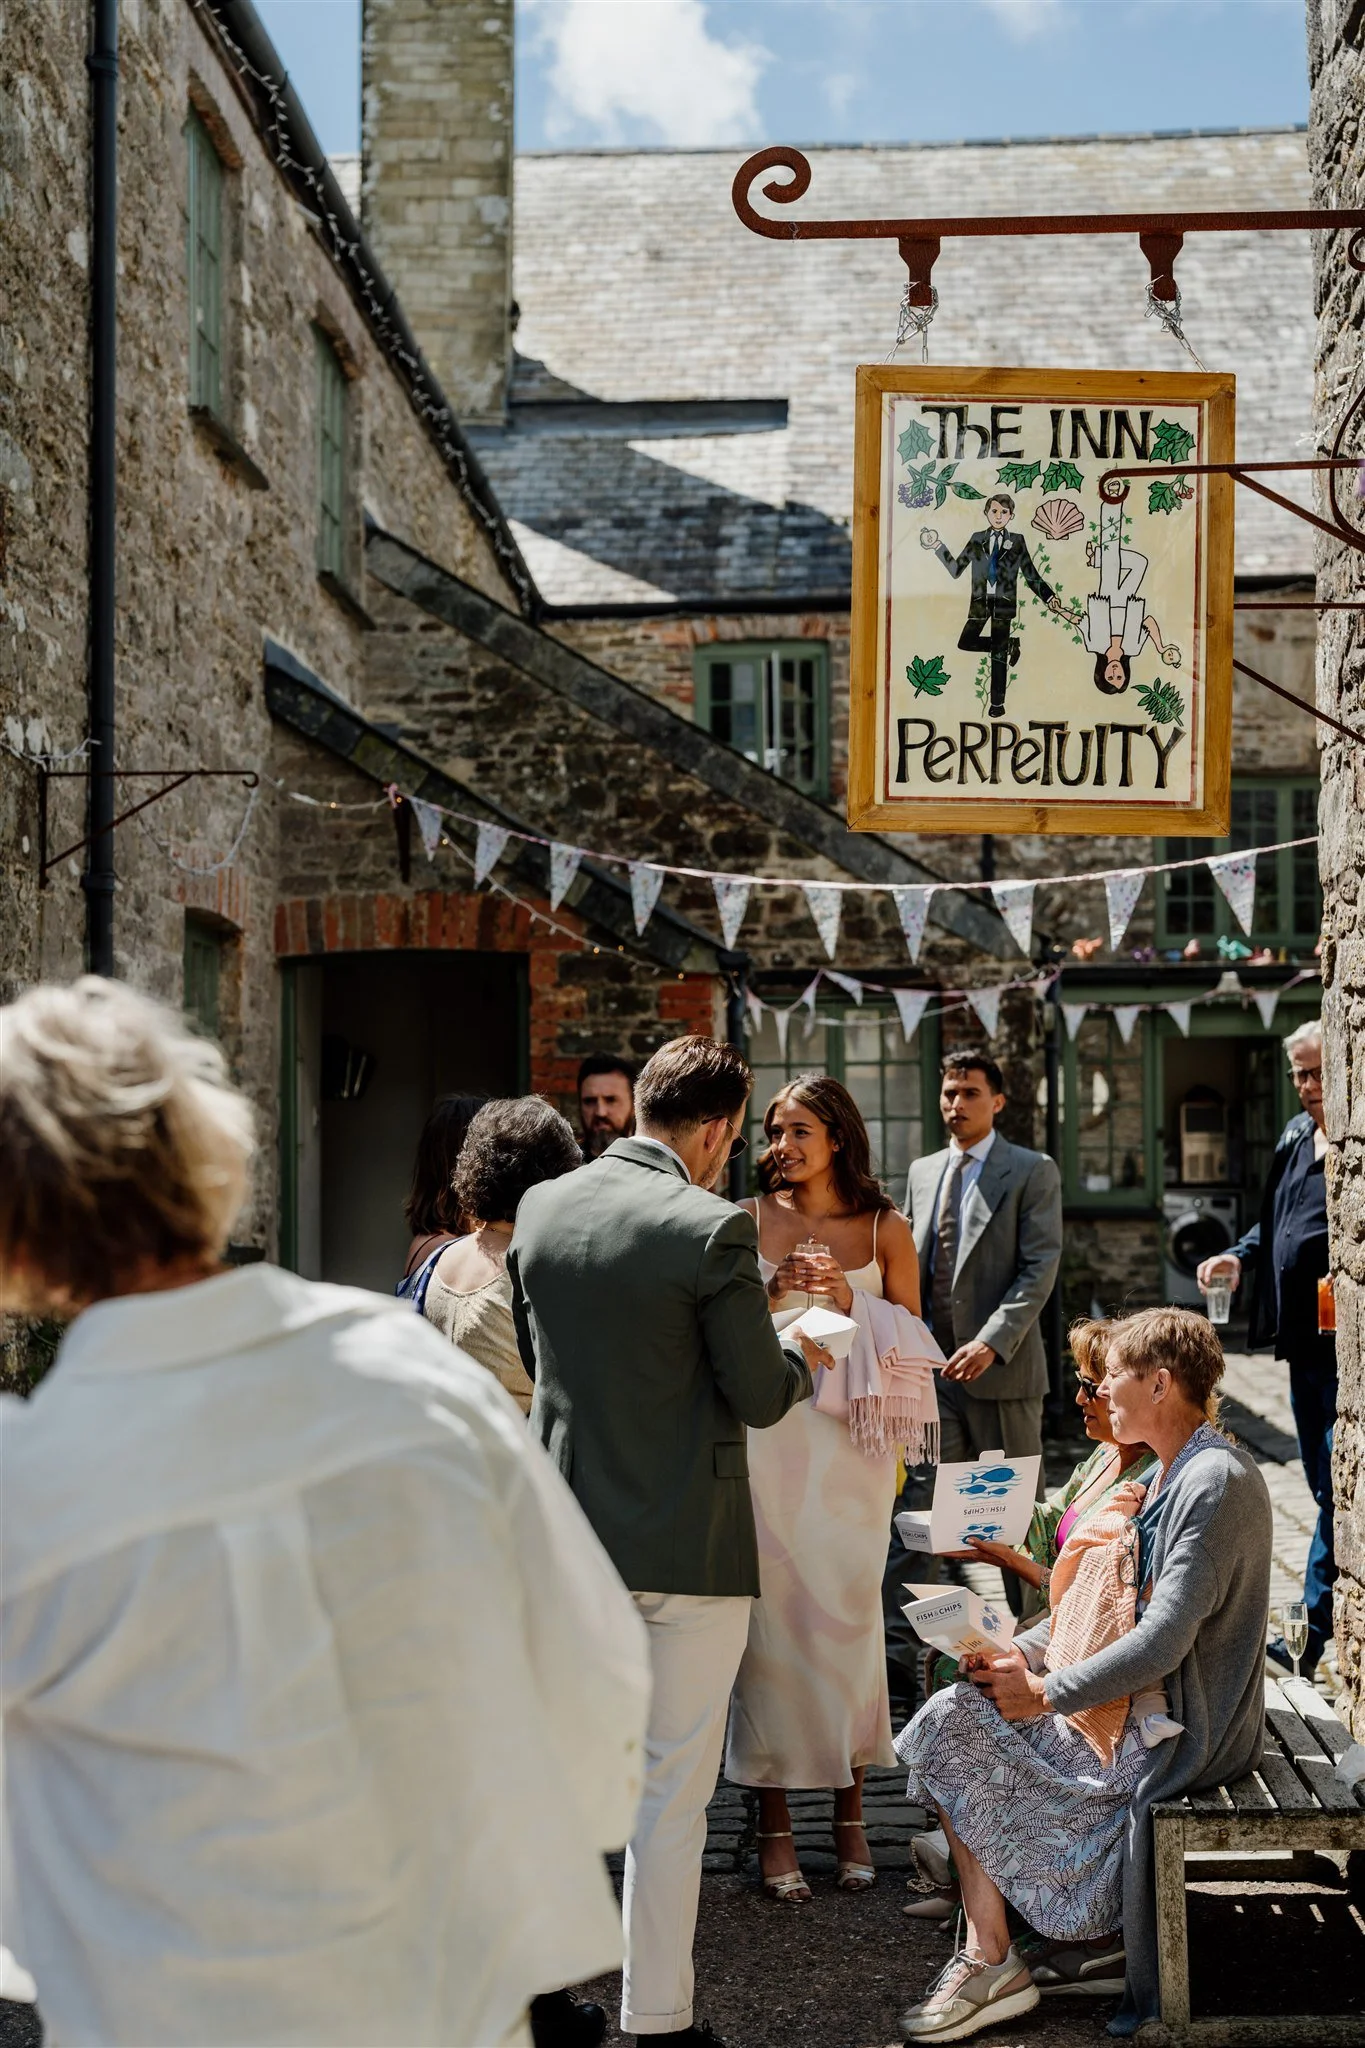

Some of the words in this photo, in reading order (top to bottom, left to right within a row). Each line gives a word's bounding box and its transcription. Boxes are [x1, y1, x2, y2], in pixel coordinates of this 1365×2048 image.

[1050, 408, 1153, 460] INN
[963, 1507, 985, 1516] CHIPS
[990, 1505, 1006, 1513] FISH
[916, 1612, 934, 1621] FISH
[939, 1602, 962, 1615] CHIPS
